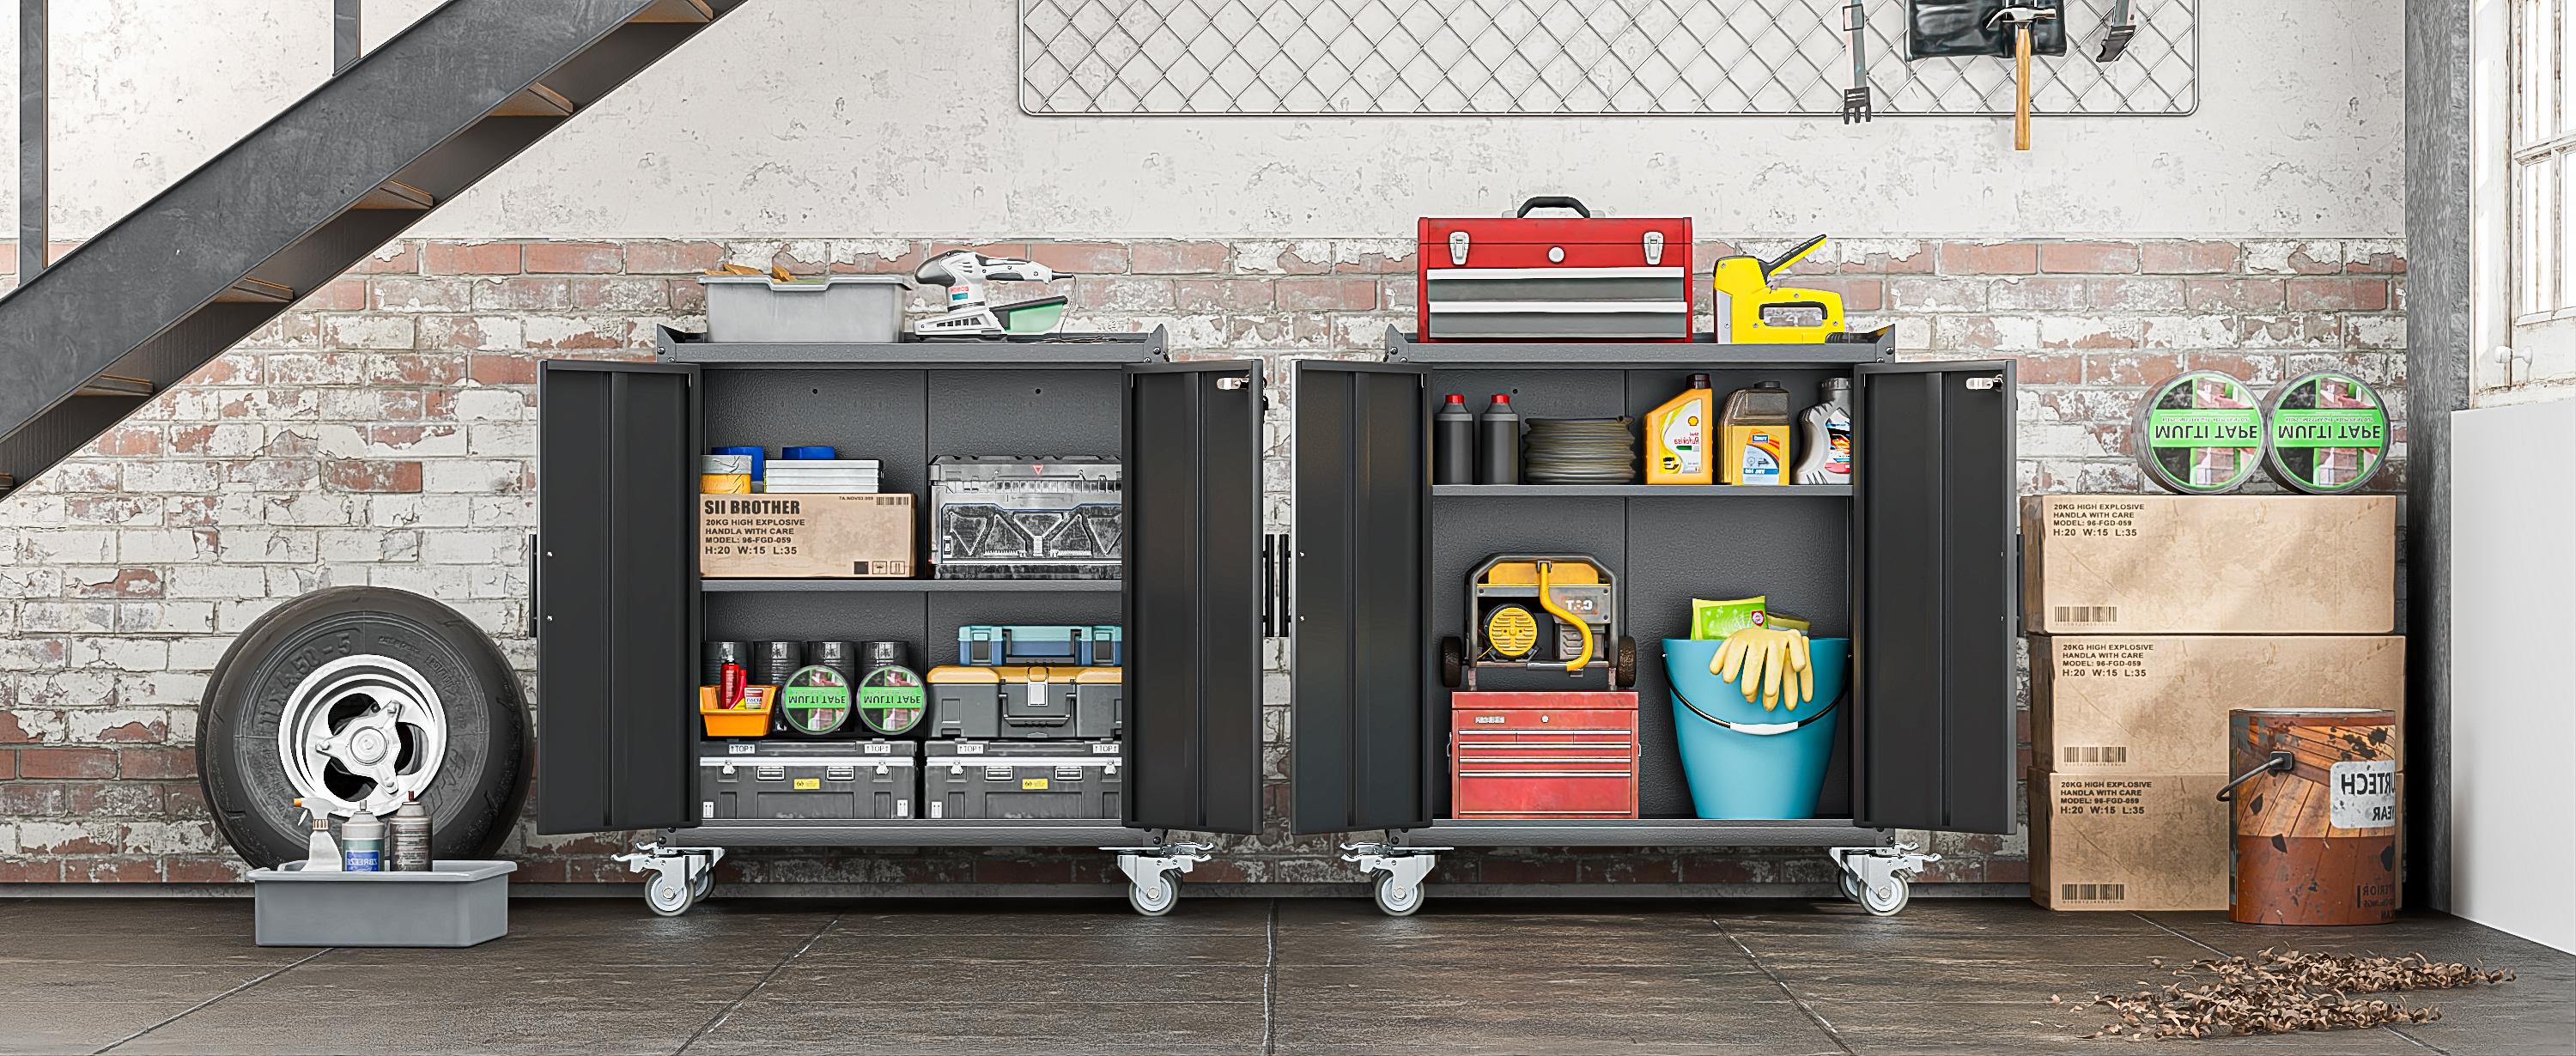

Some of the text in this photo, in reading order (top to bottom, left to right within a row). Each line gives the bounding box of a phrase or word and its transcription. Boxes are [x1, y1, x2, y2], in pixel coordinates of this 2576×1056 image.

[704, 500, 800, 515] SII BROTHER
[2053, 528, 2137, 537] H:20 W:15 L:35
[705, 545, 798, 555] H:20 W:15 L:35
[2062, 669, 2147, 677] H:20 W:15 L:35
[2060, 805, 2145, 815] H:20 W:15 L:35
